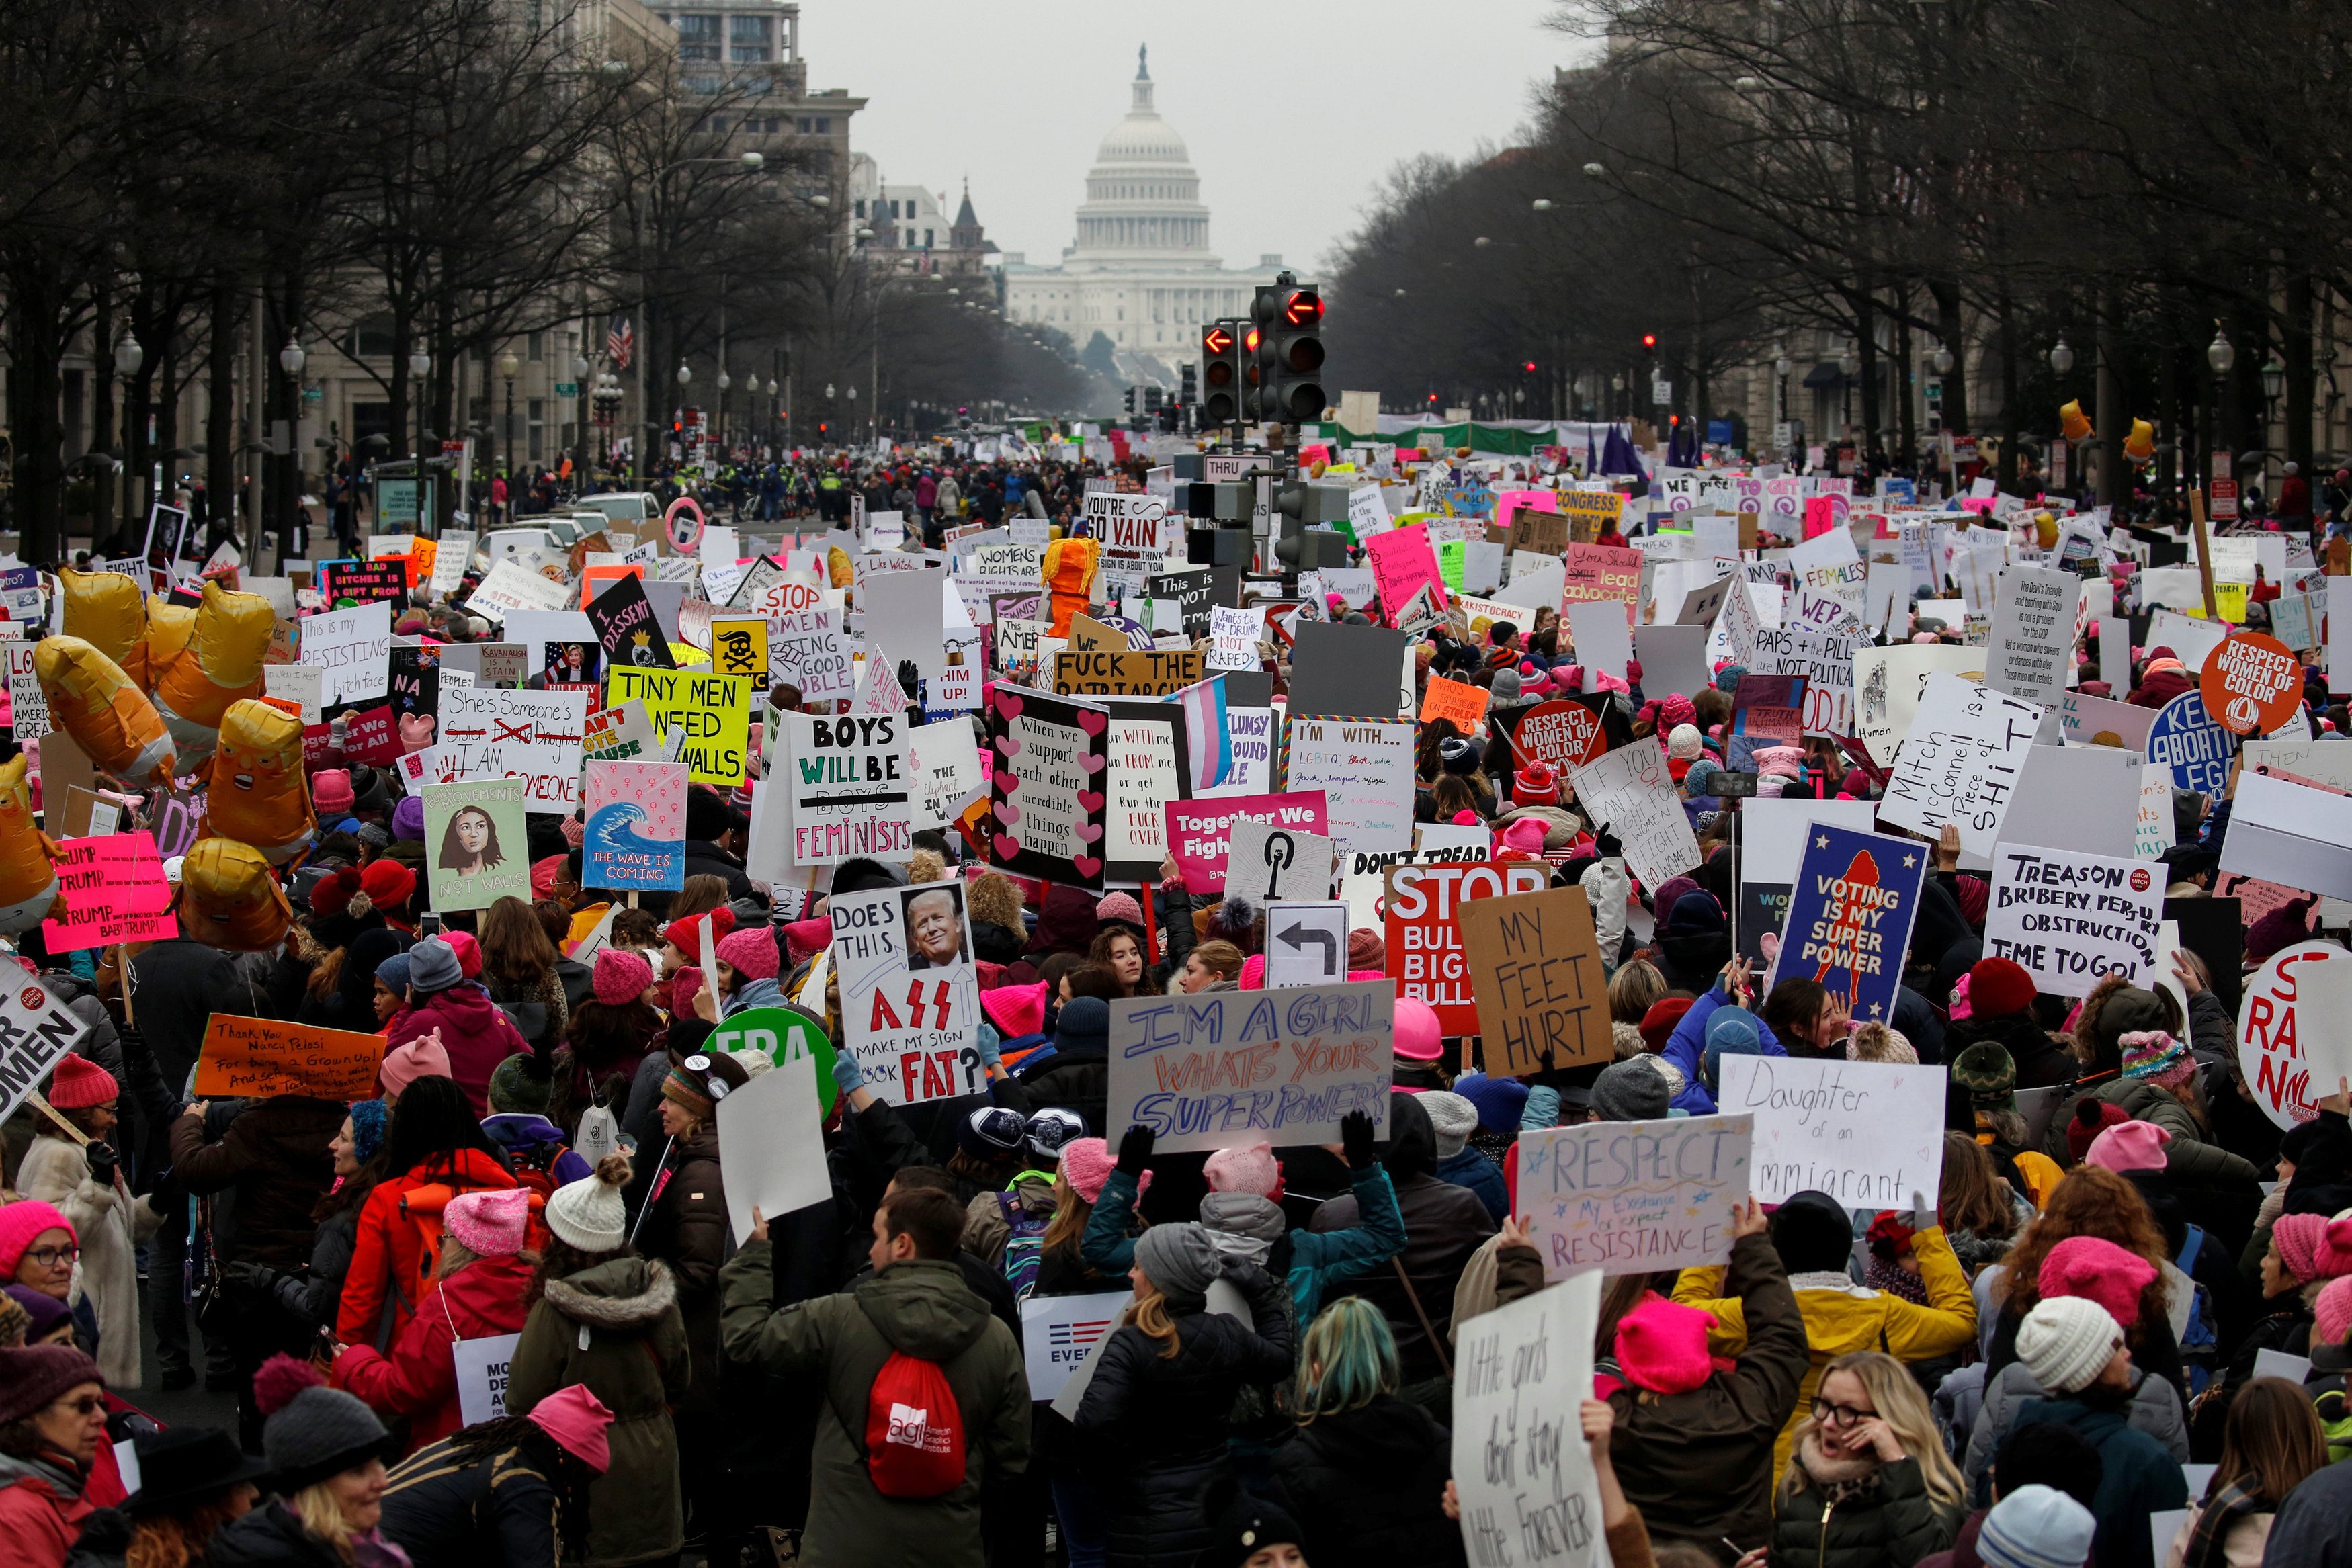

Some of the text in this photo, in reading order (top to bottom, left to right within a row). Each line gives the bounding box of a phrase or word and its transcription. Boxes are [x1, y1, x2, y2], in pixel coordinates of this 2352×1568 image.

[1210, 462, 1240, 475] THRU
[1738, 478, 1847, 495] TO GET HER
[1088, 497, 1125, 515] YOU'RE
[1556, 492, 1618, 511] CONGRESS:
[1087, 515, 1157, 548] SO VAIN
[625, 548, 646, 564] TEACH
[980, 548, 1035, 564] WOMENS
[1142, 552, 1163, 561] THINK
[1634, 539, 1673, 550] IMPEACH
[342, 563, 387, 572] US BAD
[1101, 560, 1163, 572] SIGN IS ABOUT YOU
[1574, 547, 1639, 568] You Should
[336, 575, 398, 584] BITCHES IS
[1600, 570, 1639, 588] lead
[1807, 562, 1866, 586] FEMALES
[343, 588, 366, 596] GIFT
[372, 587, 400, 596] FROM
[765, 584, 820, 609] STOP
[2029, 582, 2044, 594] Devil's
[2044, 584, 2062, 597] Triangle
[303, 617, 355, 637] This is my
[598, 609, 610, 625] I
[604, 599, 650, 652] DISSENT
[1212, 619, 1259, 636] get DRUNK
[1214, 609, 1254, 625] Wants to
[1220, 638, 1246, 650] NOT
[1756, 630, 1851, 660] PAPS the PILL
[2039, 628, 2048, 639] GOP
[302, 637, 389, 668] RESISTING
[482, 646, 526, 658] KAVANAUGH
[1210, 648, 1250, 666] RAPED
[2017, 643, 2033, 652] woman
[2033, 644, 2042, 653] who
[2044, 646, 2060, 656] swears
[2226, 639, 2295, 674] RESPECT
[485, 668, 515, 677] STAIN
[1057, 653, 1196, 679] FUCK THE
[1776, 659, 1806, 674] NOT
[2004, 669, 2052, 685] Those men will rebuke
[2217, 653, 2296, 692] WOMEN OF
[333, 673, 385, 697] bitch face
[618, 672, 735, 707] TINY MEN
[2224, 674, 2275, 704] COLOR
[449, 690, 572, 720] She's Someone's
[2226, 697, 2259, 724] NOW
[655, 711, 721, 738] NEED
[814, 717, 894, 748] BOYS
[1021, 717, 1078, 743] When we
[1524, 709, 1586, 734] RESPECT
[1749, 717, 1800, 727] ULTIMATELY
[1124, 730, 1154, 746] WITH
[1521, 724, 1594, 750] WOMEN OF
[451, 744, 503, 773] I AM
[1028, 740, 1074, 765] support
[1126, 753, 1153, 769] FROM
[1536, 742, 1584, 762] COLOR
[800, 754, 900, 785] WILL BE
[1017, 766, 1081, 790] each other
[1572, 744, 1656, 803] IF YOU
[1892, 732, 1947, 801] Mitch
[1952, 739, 2002, 817] Piece of
[1120, 777, 1153, 791] or get
[1922, 734, 1973, 829] McConnell
[1022, 793, 1073, 814] incredible
[1120, 795, 1161, 810] Run the
[1589, 781, 1634, 830] DON'T
[1648, 782, 1679, 809] FOR
[1026, 812, 1070, 840] things
[1130, 812, 1159, 827] FUCK
[1632, 805, 1671, 841] WOMEN
[1024, 829, 1072, 856] happen.
[1130, 830, 1161, 846] OVER
[1639, 822, 1681, 861] FIGHT
[593, 851, 670, 865] THE WAVE IS
[1644, 842, 1700, 887] NO WOMEN
[607, 867, 665, 881] COMING
[2008, 853, 2124, 889] TREASON
[1817, 875, 1899, 909] VOTING
[833, 900, 895, 930] DOES
[1822, 900, 1885, 928] IS MY
[1500, 907, 1543, 957] MY
[1811, 920, 1882, 953] SUPER
[2022, 915, 2156, 967] OBSTRUCTION
[837, 932, 893, 959] THIS
[1801, 941, 1882, 975] POWER
[1495, 953, 1589, 1009] FEET
[216, 1023, 282, 1040] Thank You
[1125, 998, 1278, 1058] I'M A
[1503, 1006, 1591, 1070] HURT
[249, 1037, 323, 1054] Nancy Pelosi
[857, 1029, 962, 1060] MAKE MY SIGN
[1291, 1036, 1379, 1081] YOUR
[900, 1047, 980, 1102] FAT?
[1746, 1060, 1869, 1125] Daughter
[1813, 1121, 1852, 1140] of an
[1553, 1129, 1735, 1193] RESPECT
[1552, 1223, 1721, 1267] RESISTANCE
[890, 1418, 925, 1444] agi
